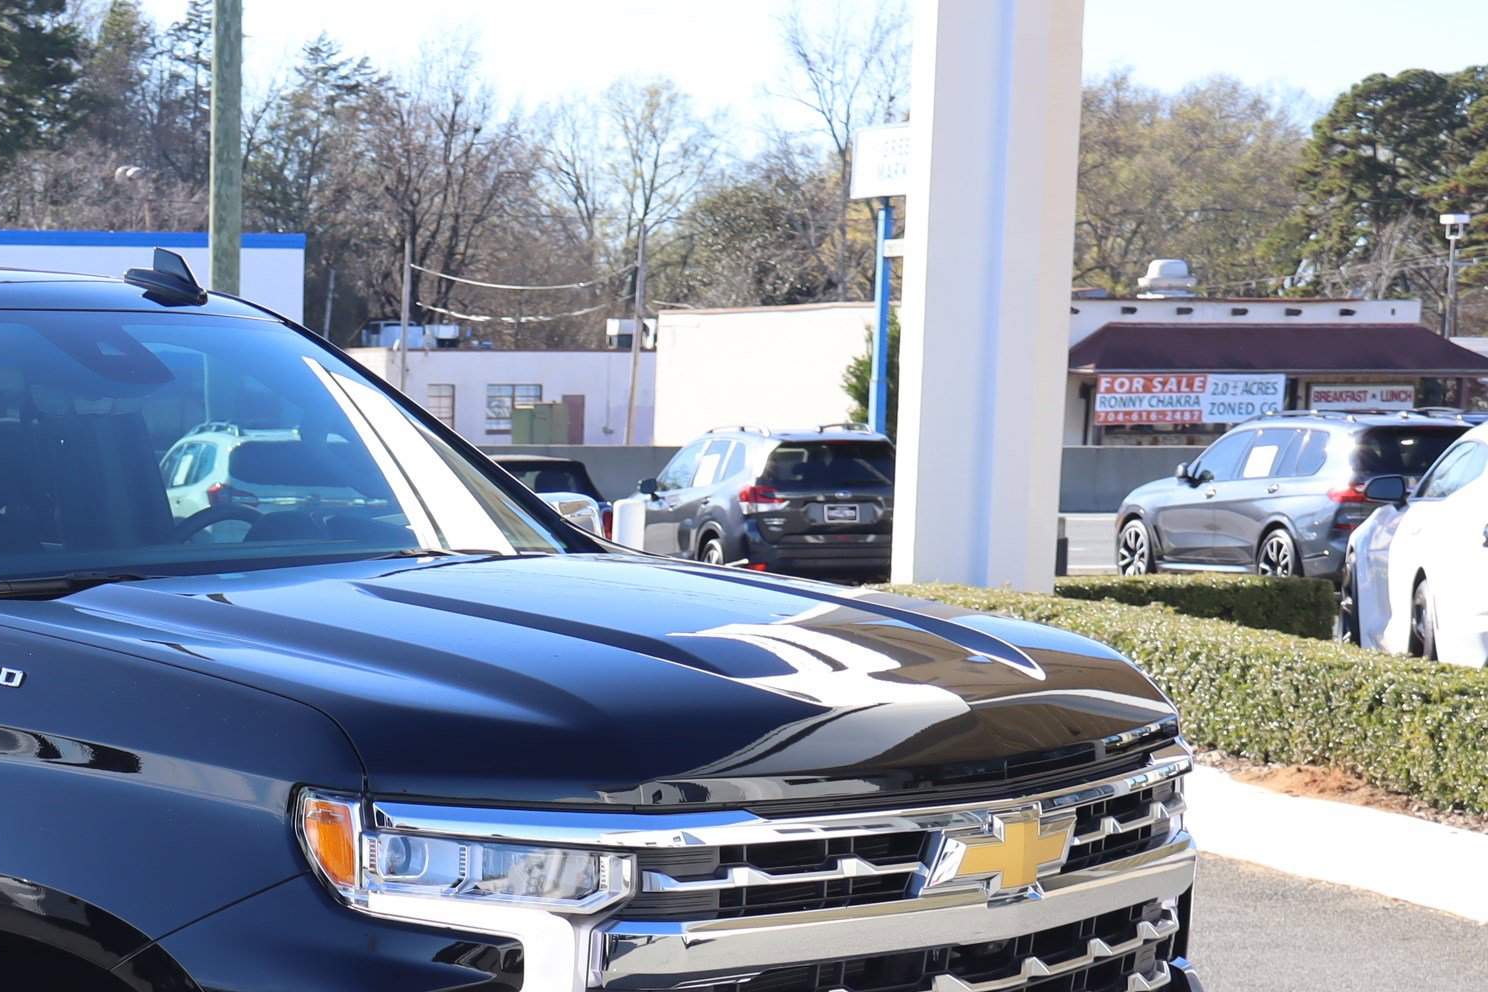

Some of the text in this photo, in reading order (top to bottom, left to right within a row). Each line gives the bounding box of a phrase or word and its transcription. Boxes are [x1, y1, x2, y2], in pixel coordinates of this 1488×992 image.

[1099, 376, 1206, 393] FOR SALE
[1211, 382, 1229, 396] 2.0
[1240, 381, 1279, 396] ACRES
[1098, 395, 1201, 408] RONNY CHAKRA
[1313, 389, 1412, 403] BREAKFAST LUNCH
[1208, 402, 1255, 416] ZONED
